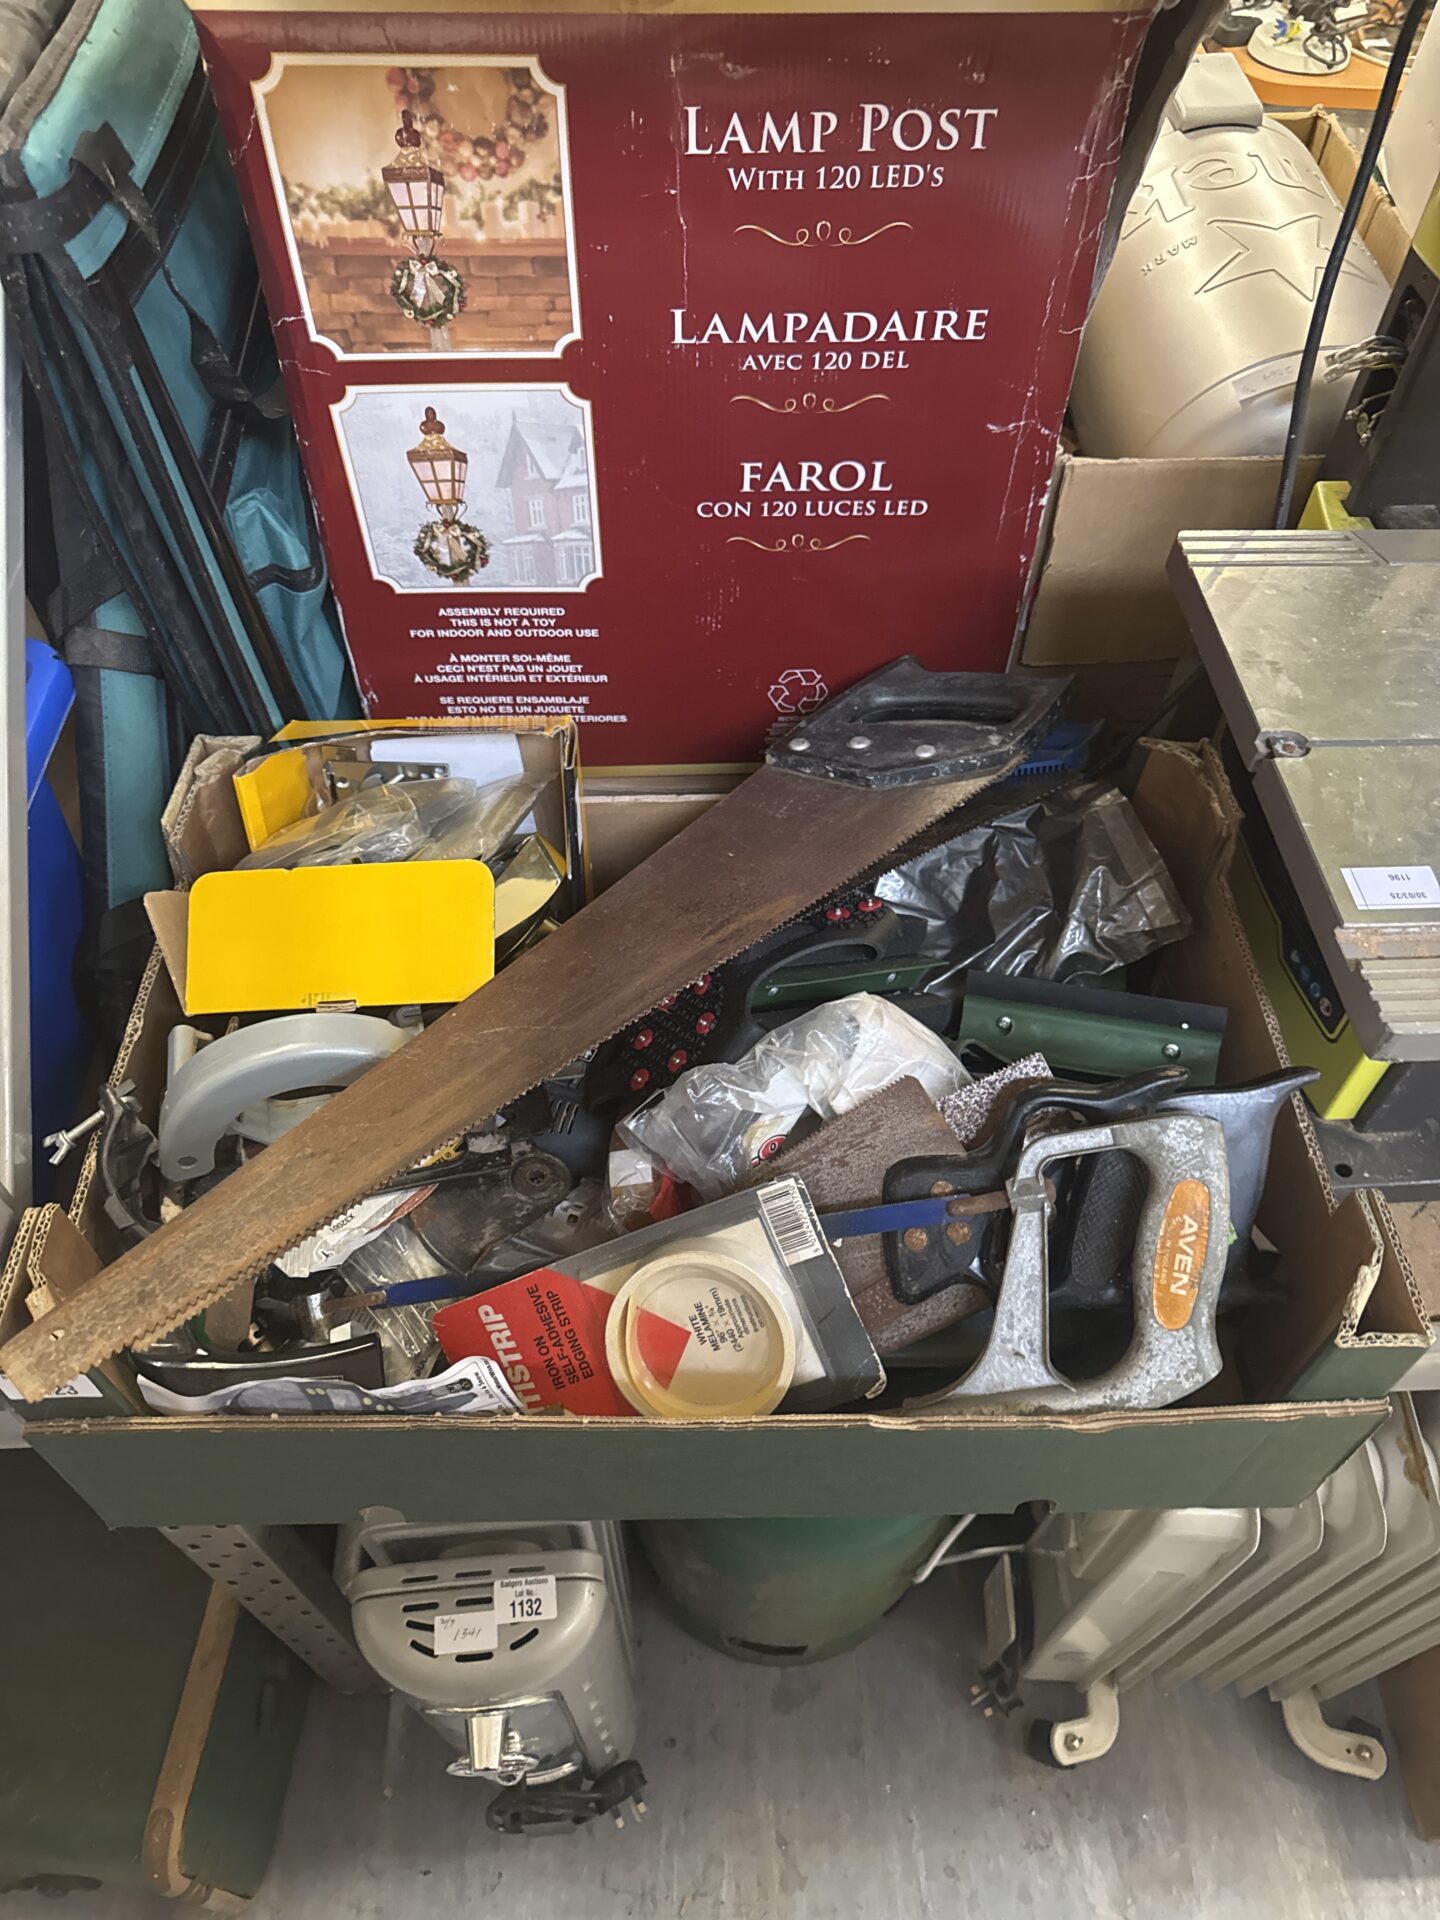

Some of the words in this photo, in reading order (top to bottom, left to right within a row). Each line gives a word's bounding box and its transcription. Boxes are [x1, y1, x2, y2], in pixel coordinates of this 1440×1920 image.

[683, 105, 838, 155] LAMP
[858, 102, 999, 152] POST
[727, 167, 804, 191] WITH
[816, 165, 861, 190] 120
[1140, 235, 1198, 277] MARK
[670, 308, 989, 345] LAMPADAIRE
[742, 354, 802, 371] AVEC
[811, 352, 852, 370] 120
[860, 350, 910, 369] DEL
[739, 461, 893, 493] FAROL
[697, 501, 752, 518] CON
[760, 501, 797, 517] 120
[804, 500, 876, 517] LUCES
[883, 499, 929, 516] LED
[438, 607, 501, 617] ASSEMBLY
[503, 607, 566, 616] REQUIRED
[450, 618, 477, 627] THIS
[480, 618, 492, 627] IS
[494, 618, 519, 627] NOT
[521, 618, 531, 627] A
[532, 618, 556, 627] TOY
[409, 629, 435, 638] FOR
[437, 629, 484, 637] INDOOR
[487, 629, 512, 637] AND
[514, 629, 573, 637] OUTDOOR
[575, 629, 600, 637] USE
[449, 652, 459, 663] À
[460, 654, 510, 663] MONTER
[512, 651, 571, 663] SOI-MÊME
[424, 674, 465, 683] USAGE
[466, 673, 527, 683] INTÉRIEUR
[529, 674, 543, 683] ET
[545, 673, 608, 683] EXTÉRIEUR
[436, 665, 465, 673] CECI
[467, 664, 500, 673] N'EST
[502, 664, 525, 673] PAS
[526, 664, 544, 673] UN
[546, 664, 583, 673] JOUET
[440, 696, 455, 704] SE
[457, 696, 514, 704] REQUIERE
[516, 696, 590, 704] ENSAMBLAJE
[448, 706, 477, 714] ESTO
[479, 706, 497, 714] NO
[498, 706, 513, 714] ES
[515, 705, 532, 714] UN
[534, 705, 585, 714] JUGUETE
[329, 1212, 356, 1232] X32001
[1170, 1214, 1198, 1296] AVEN
[546, 1290, 571, 1327] STRIP
[709, 1287, 726, 1317] 19mm)
[526, 1284, 580, 1385] SELF-ADHESIVE
[688, 1314, 707, 1346] WHITE
[694, 1301, 721, 1352] MELAMINE
[533, 1336, 550, 1357] ON
[726, 1328, 744, 1352] (2440
[564, 1328, 594, 1379] EDGING
[543, 1357, 566, 1391] IRON
[525, 1577, 549, 1586] Auctions
[515, 1589, 524, 1598] Lot
[510, 1597, 543, 1619] 1132
